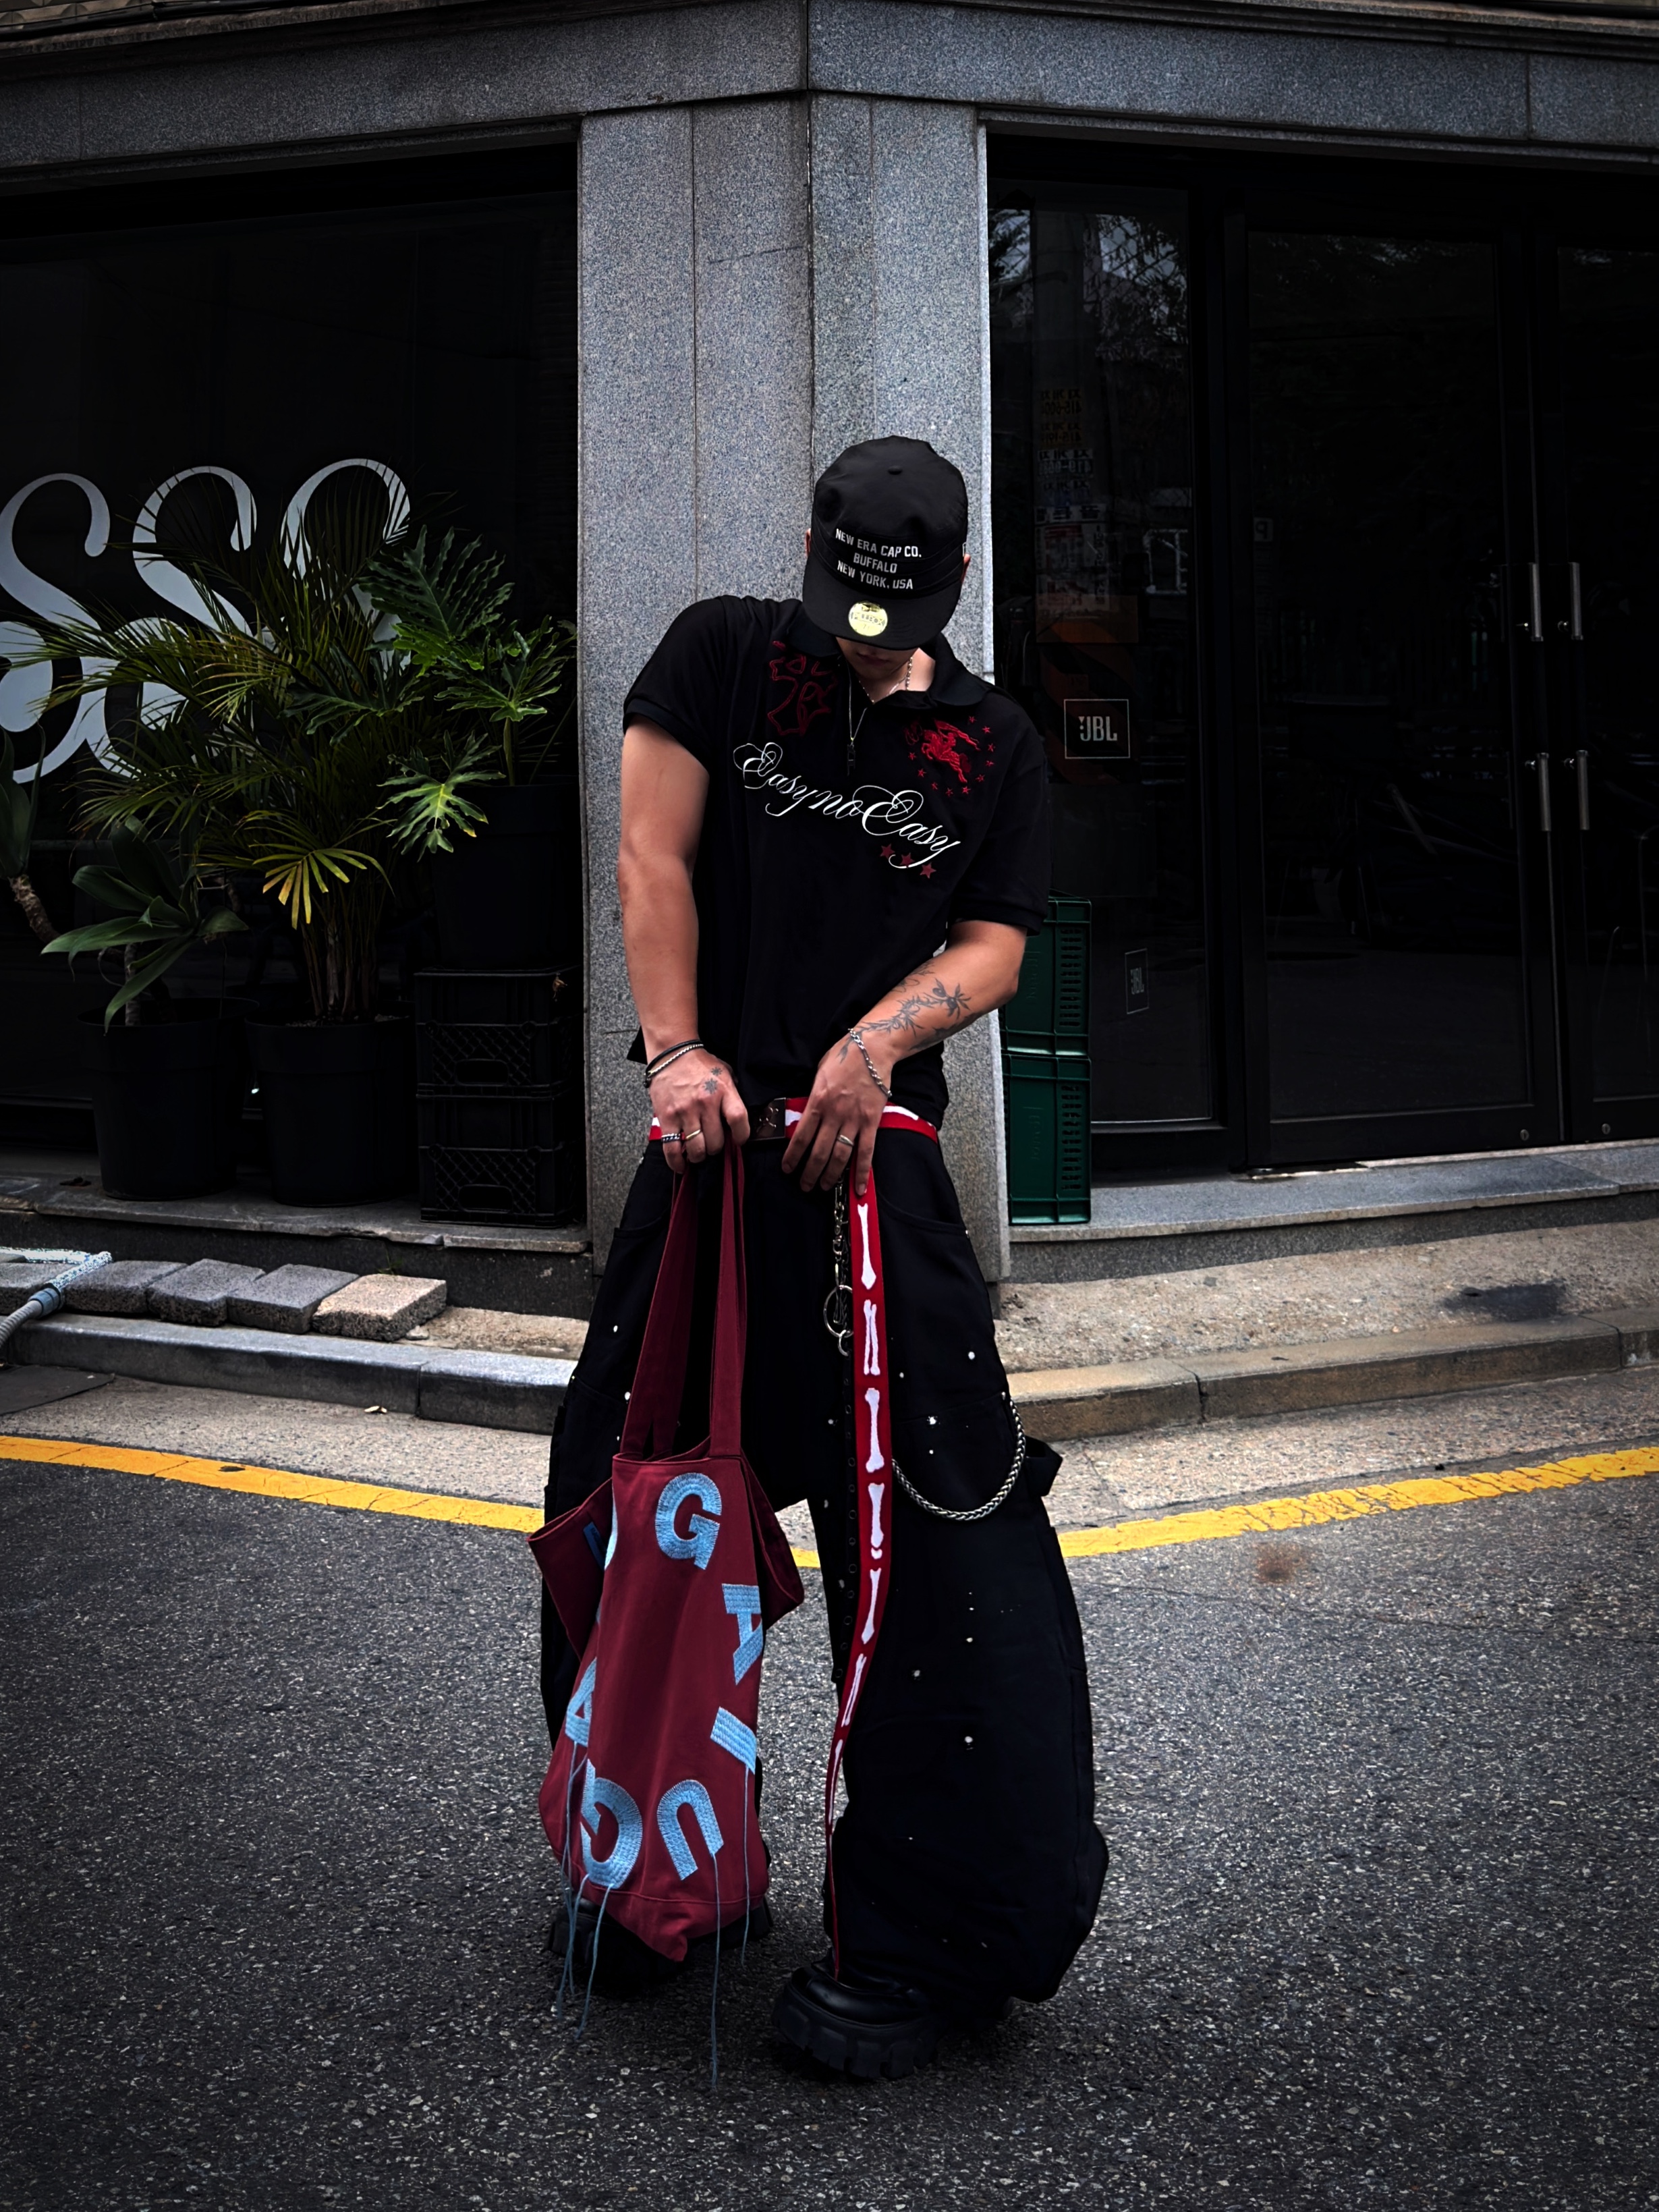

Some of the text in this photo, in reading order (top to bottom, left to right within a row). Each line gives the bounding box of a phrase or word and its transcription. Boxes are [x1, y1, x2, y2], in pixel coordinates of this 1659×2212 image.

[835, 528, 922, 557] NEW ERA CAP CO.
[837, 560, 855, 578] NEW
[893, 578, 913, 589] USA
[853, 552, 897, 574] BUFFALO
[1079, 716, 1118, 742] JBL
